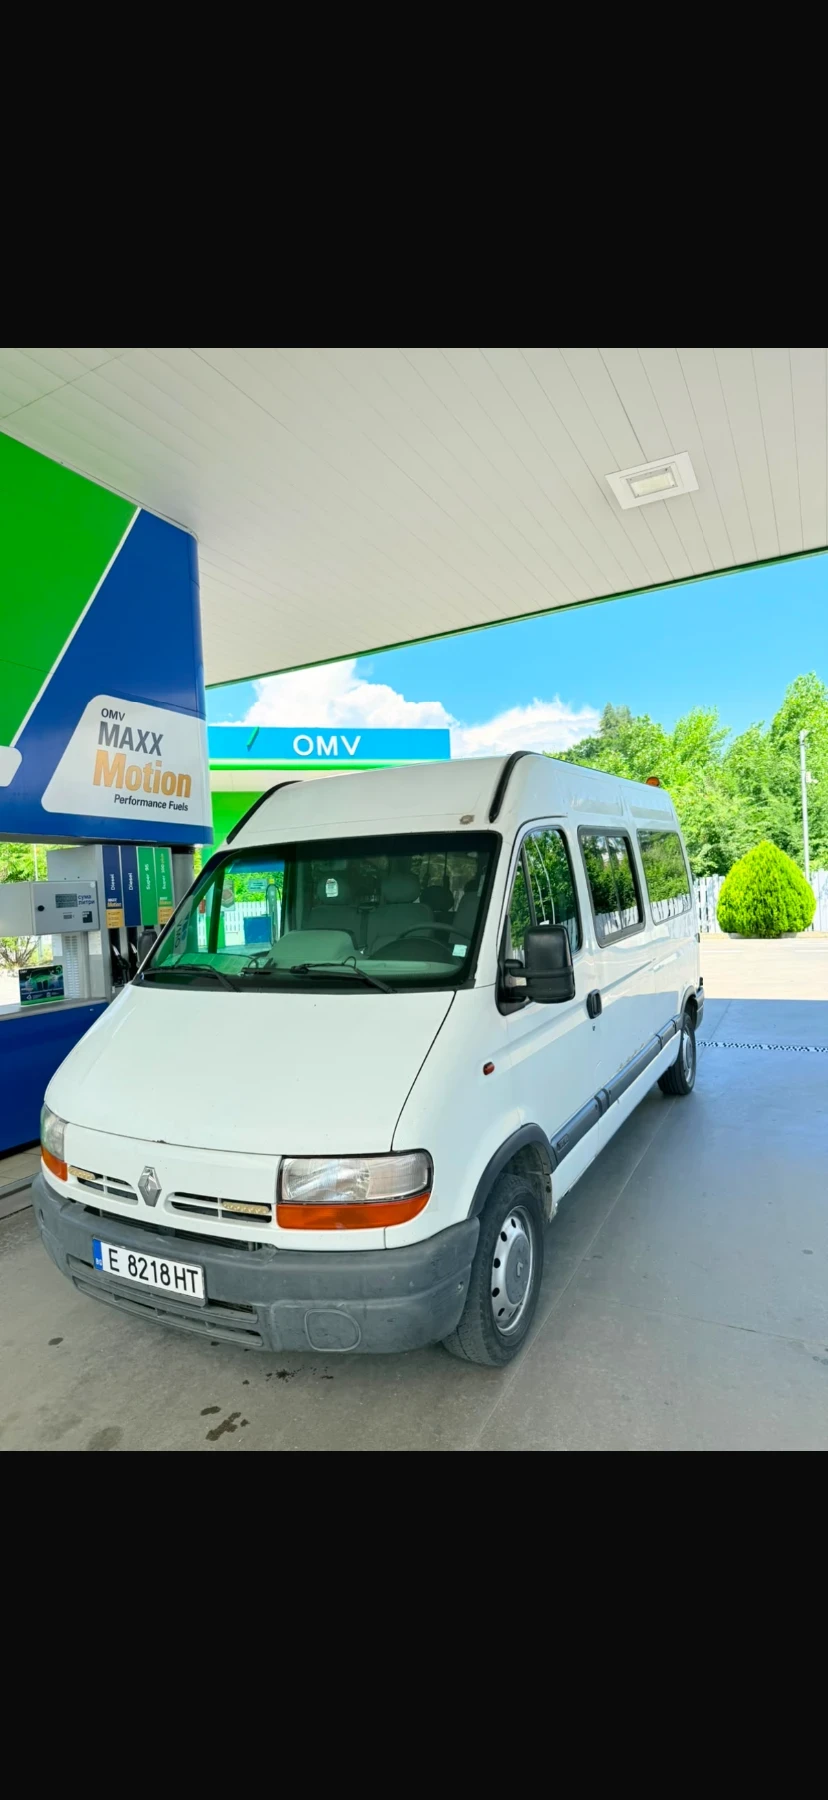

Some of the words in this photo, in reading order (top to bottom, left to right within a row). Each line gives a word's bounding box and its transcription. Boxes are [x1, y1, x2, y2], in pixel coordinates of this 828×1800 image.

[101, 707, 126, 721] OMV
[98, 720, 164, 756] MAXX
[292, 734, 362, 756] OMV
[92, 749, 192, 798] Motion
[113, 793, 167, 809] Performance
[168, 801, 189, 812] Fuels
[108, 1248, 120, 1273] E
